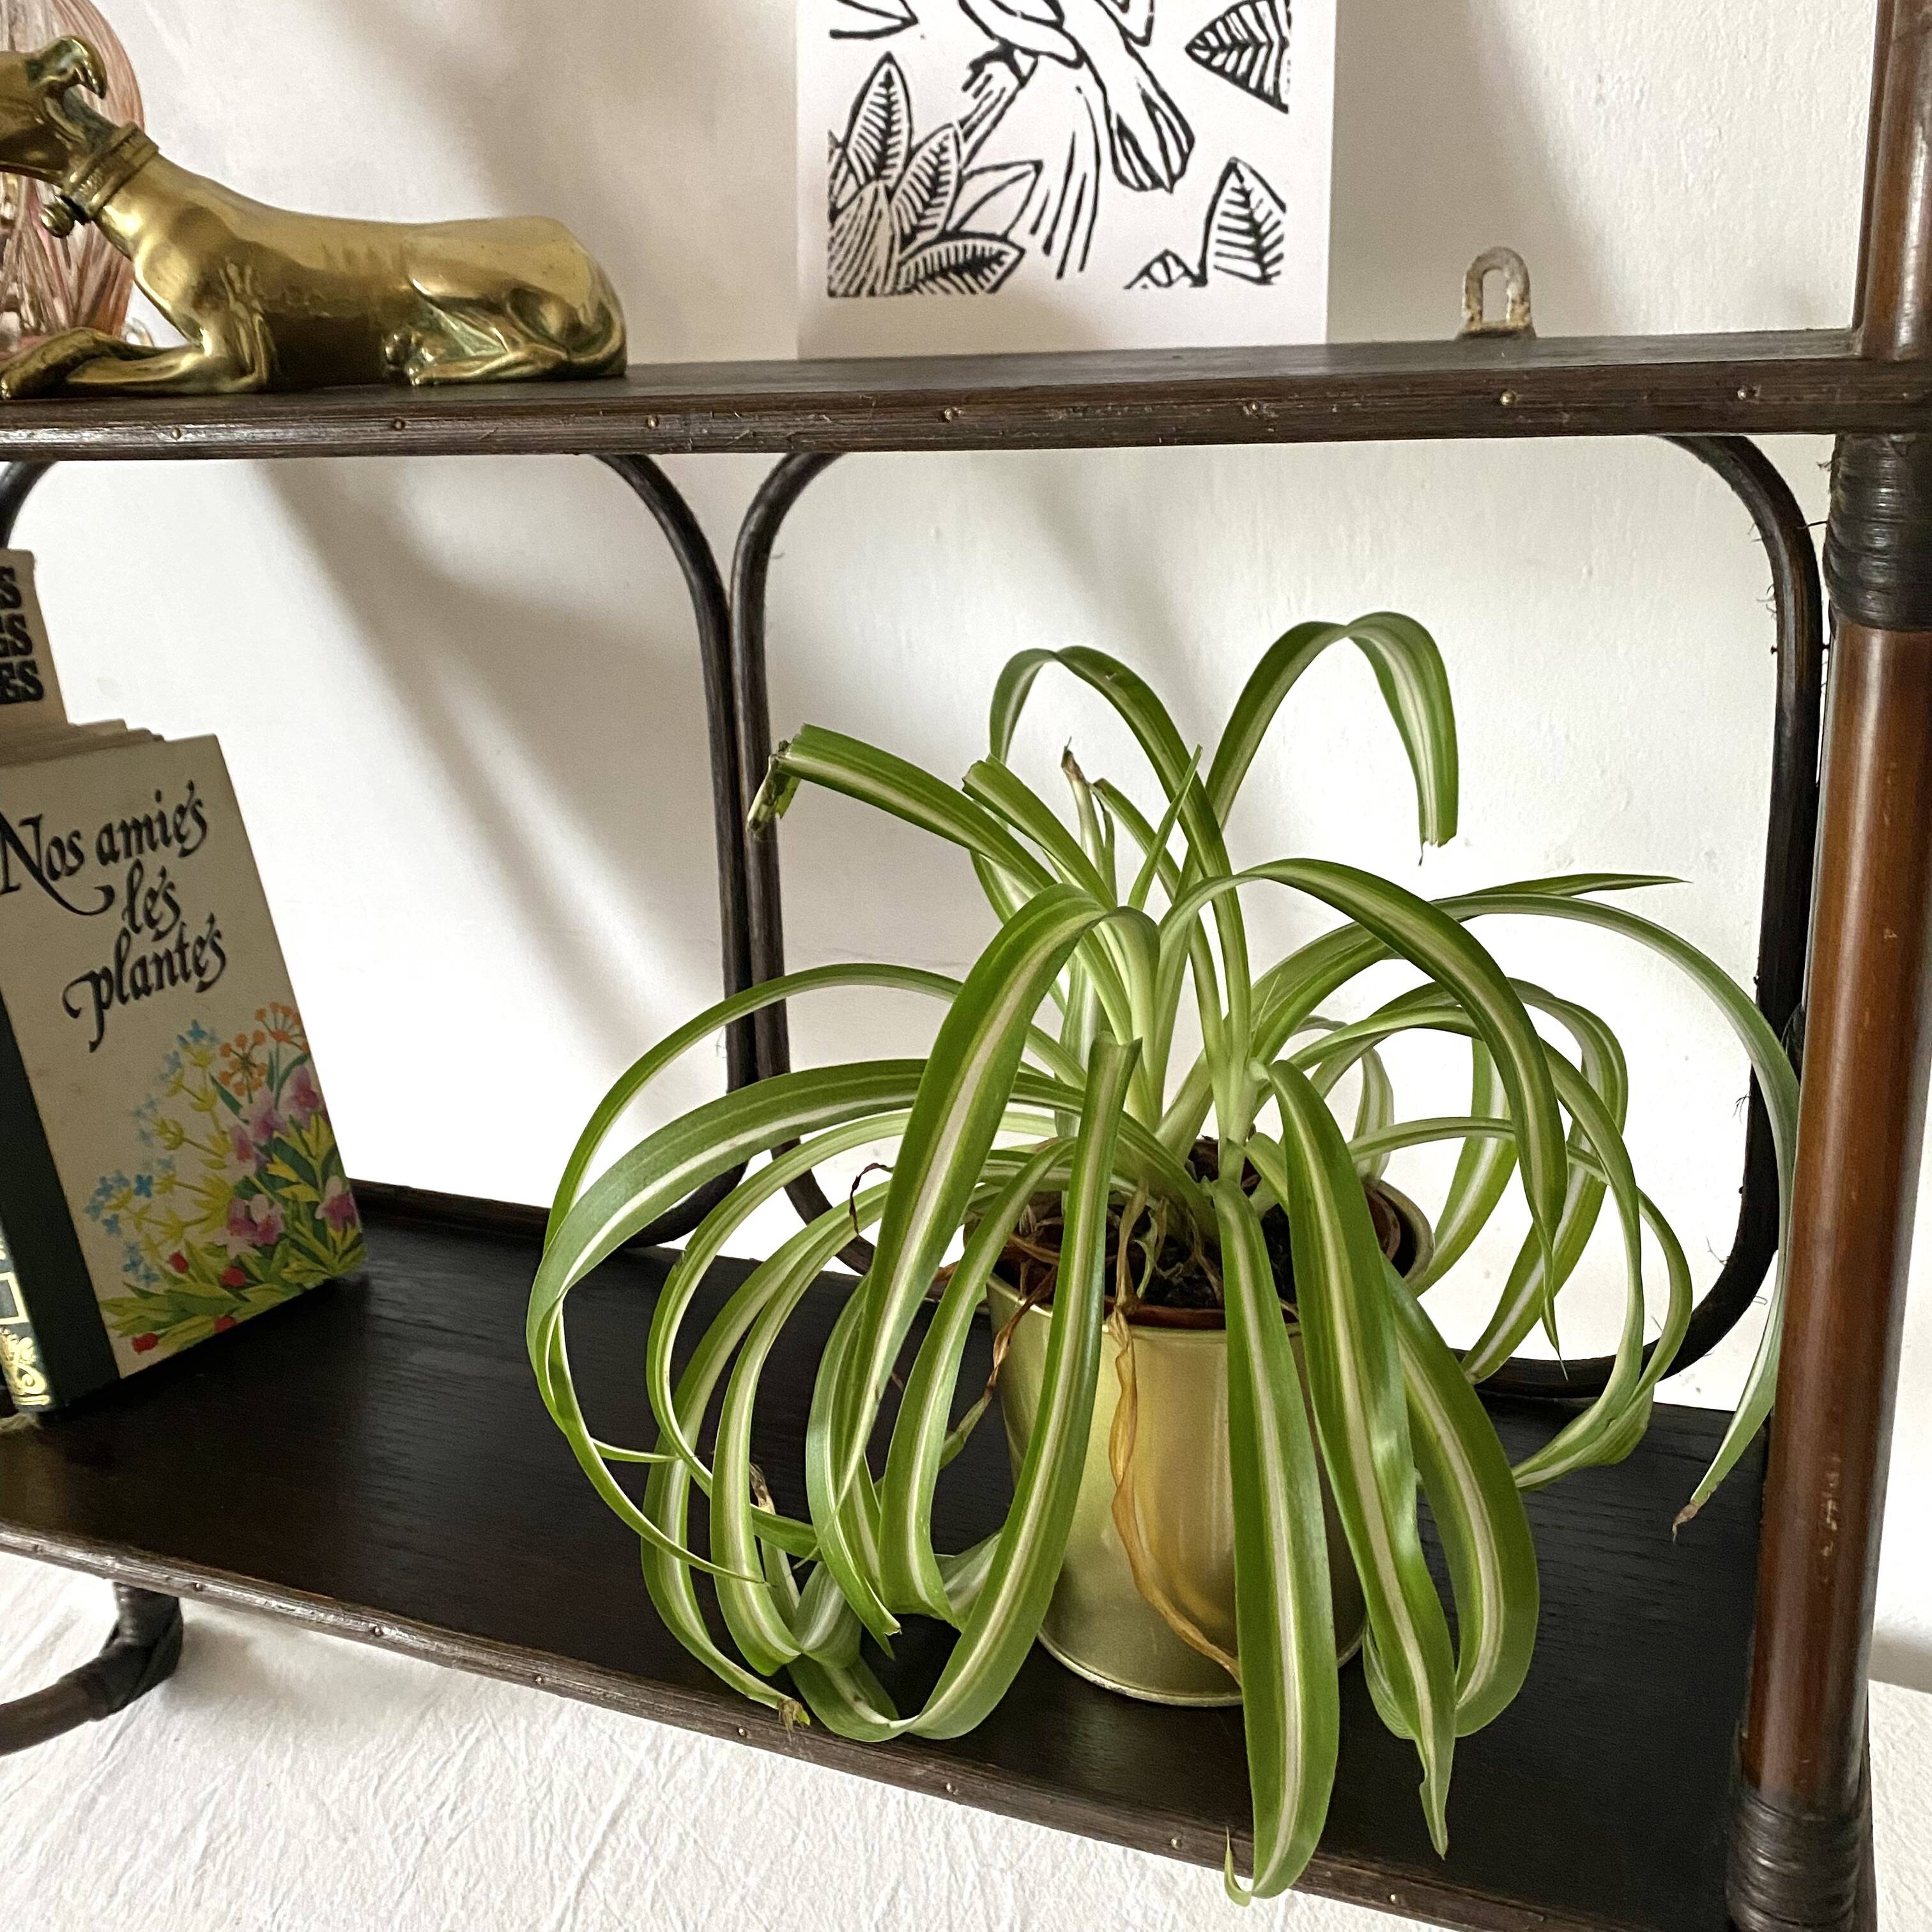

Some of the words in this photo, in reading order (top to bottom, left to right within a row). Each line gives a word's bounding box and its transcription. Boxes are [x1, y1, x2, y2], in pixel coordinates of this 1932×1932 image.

[0, 812, 115, 916] Nos
[95, 779, 208, 866] amies
[121, 858, 181, 942] les
[61, 912, 226, 1053] plantes
